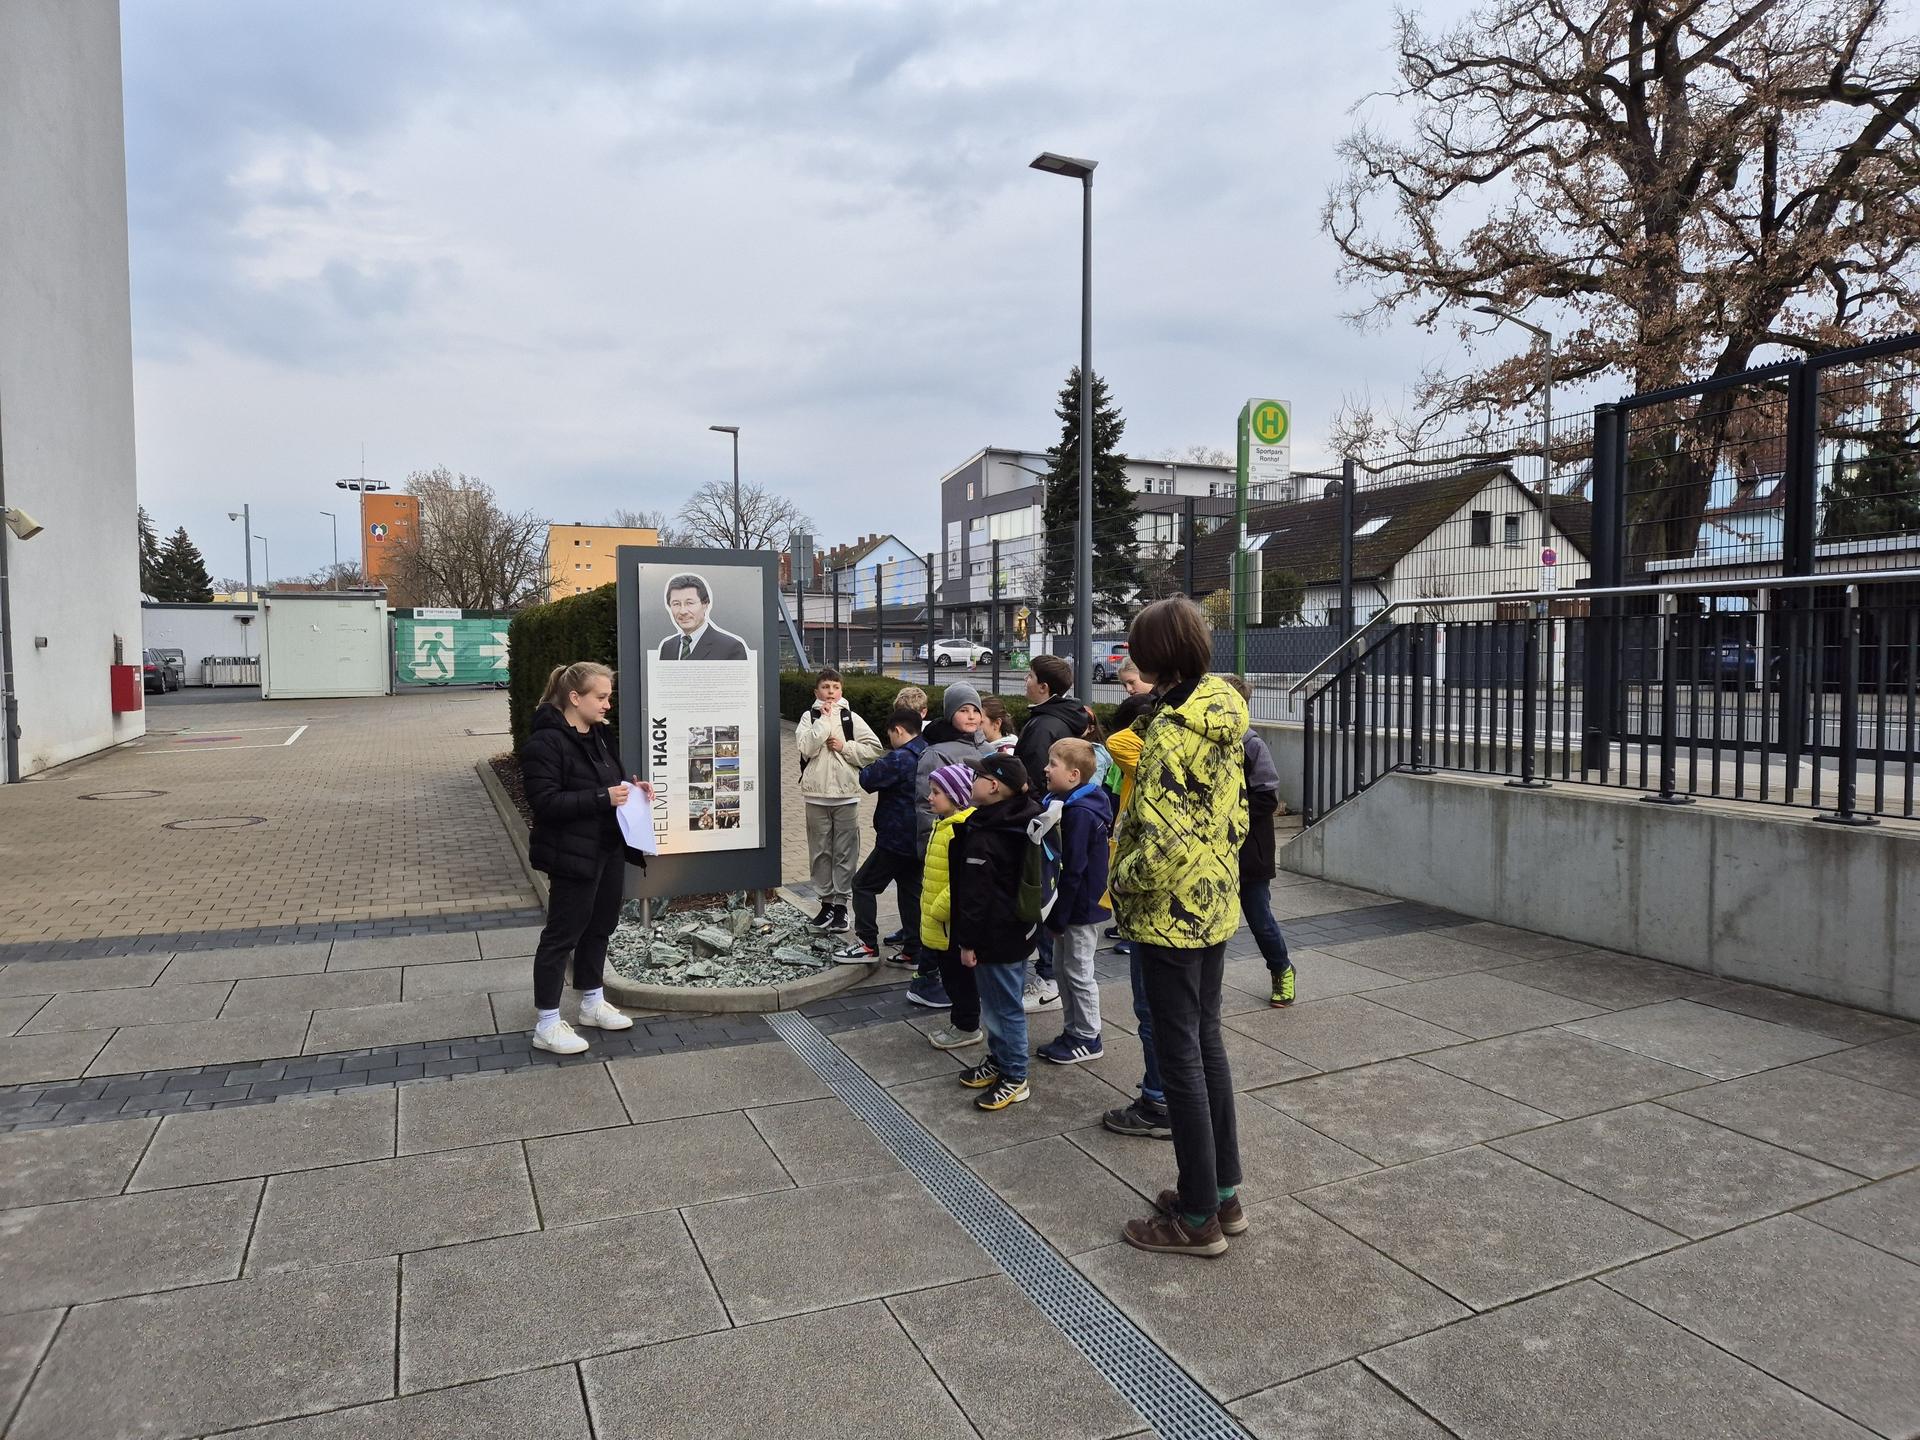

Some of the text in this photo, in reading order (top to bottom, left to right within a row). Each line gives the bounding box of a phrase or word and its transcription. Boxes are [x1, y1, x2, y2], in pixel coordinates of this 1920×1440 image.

[1262, 410, 1279, 434] H
[652, 717, 668, 845] HELMUT HACK
